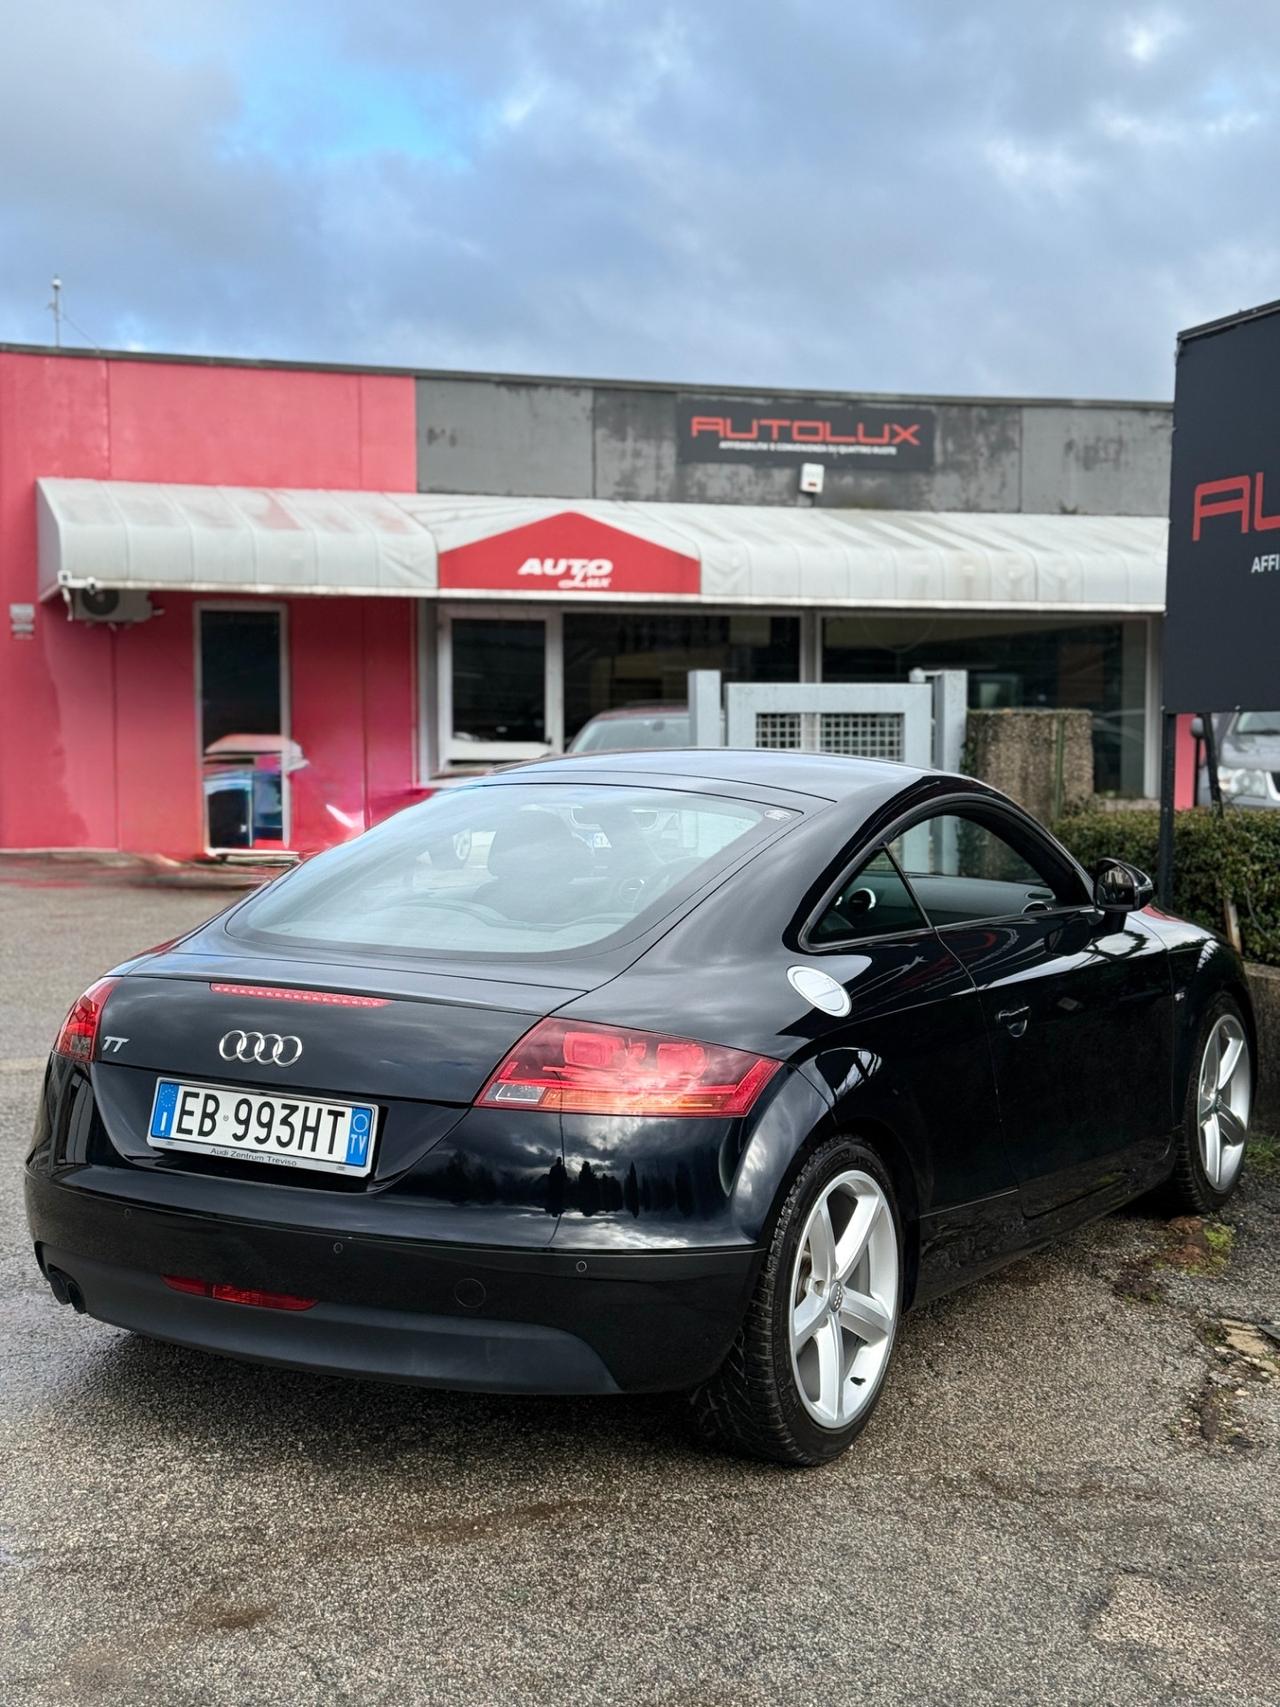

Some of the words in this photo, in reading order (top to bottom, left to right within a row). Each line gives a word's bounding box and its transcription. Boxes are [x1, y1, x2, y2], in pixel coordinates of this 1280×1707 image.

[691, 416, 920, 445] AUTOLUX
[518, 558, 613, 576] AUTO
[102, 1036, 129, 1052] TT
[176, 1090, 220, 1137] EB
[232, 1098, 345, 1154] 993HT
[350, 1134, 367, 1155] TV
[210, 1147, 229, 1155] Audi
[230, 1150, 265, 1161] Zentrum
[267, 1155, 297, 1167] Treviso
